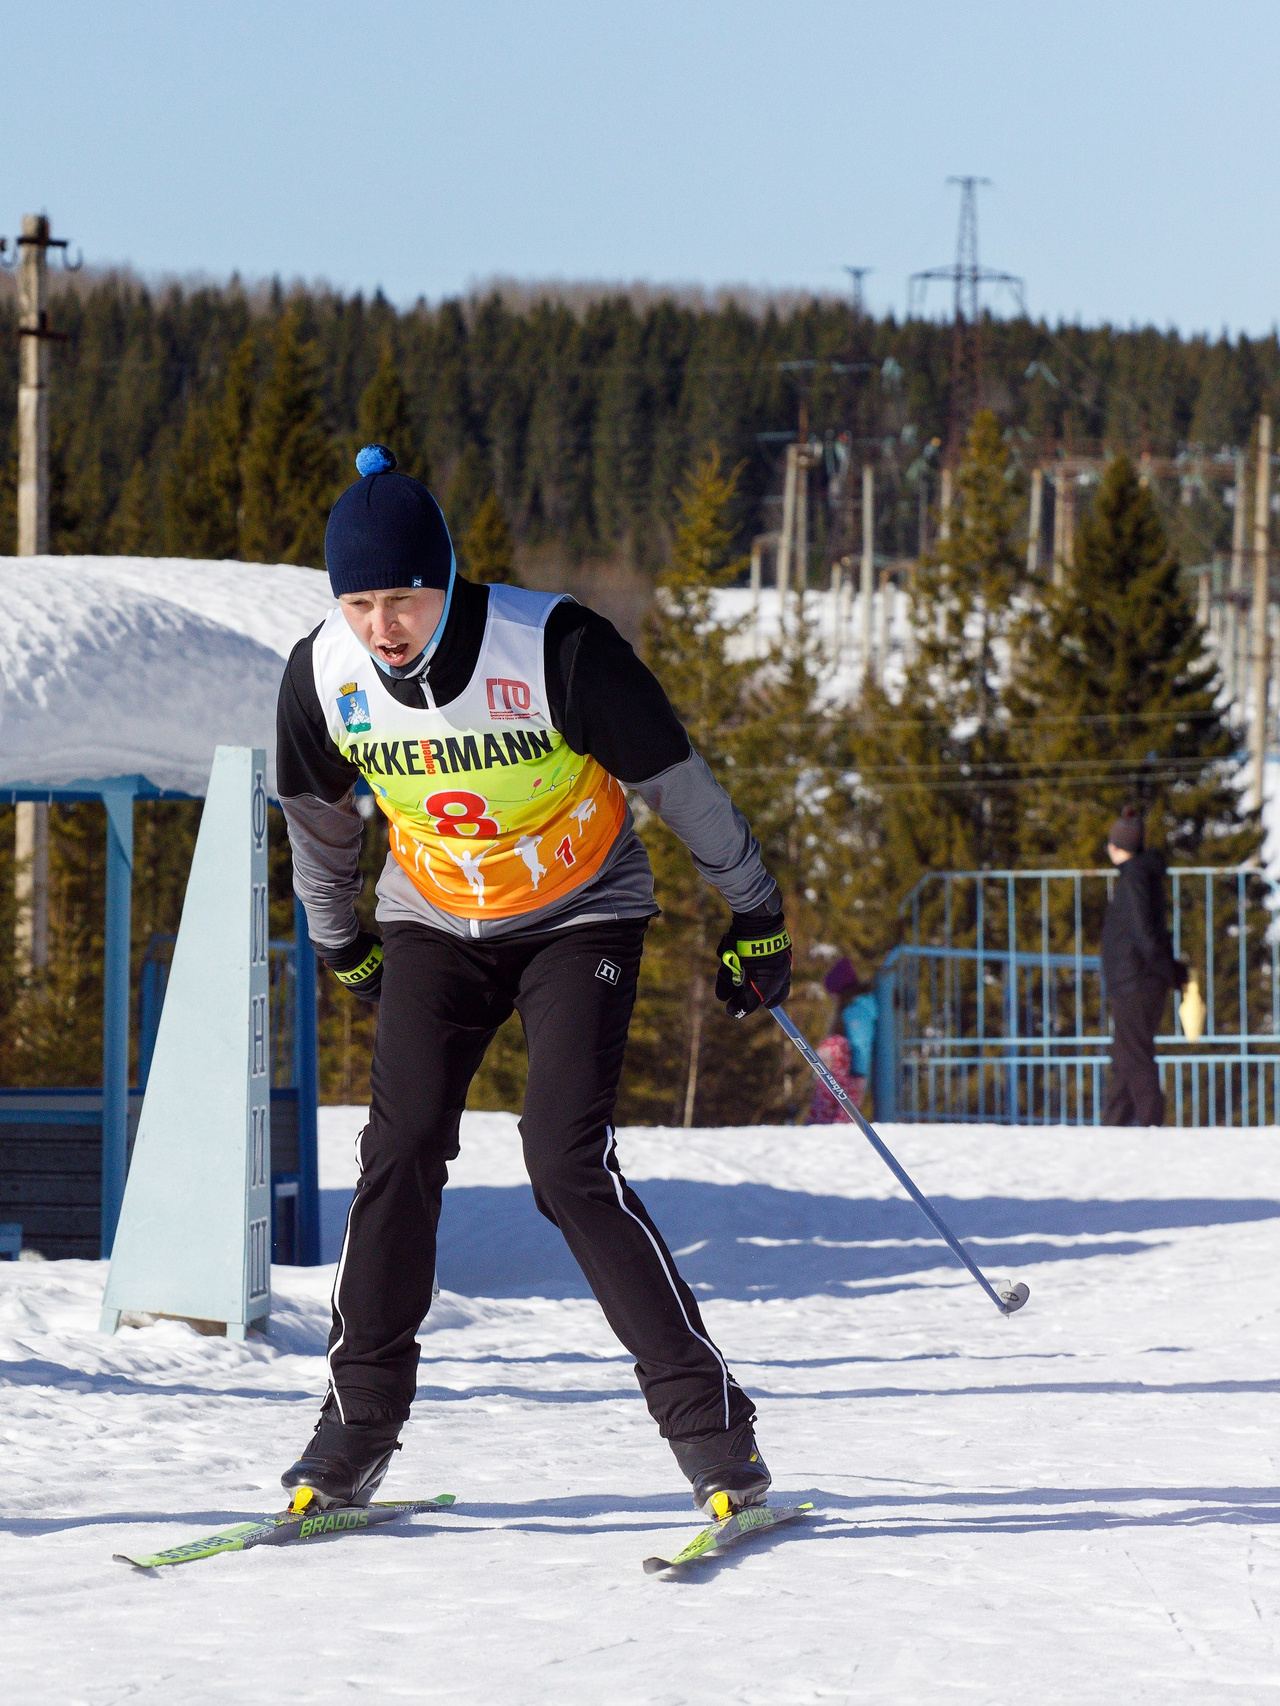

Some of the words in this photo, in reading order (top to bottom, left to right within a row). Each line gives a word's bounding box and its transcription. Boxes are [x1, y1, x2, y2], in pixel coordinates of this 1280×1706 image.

[485, 678, 531, 711] ГТО
[348, 729, 554, 776] AKKERMANN
[419, 739, 437, 775] cement
[423, 789, 500, 840] 8
[555, 834, 577, 869] 1
[250, 772, 268, 1301] ФИНИШ
[826, 1073, 848, 1100] Cyber
[299, 1510, 370, 1538] BRADOS
[736, 1506, 775, 1532] BRADOS
